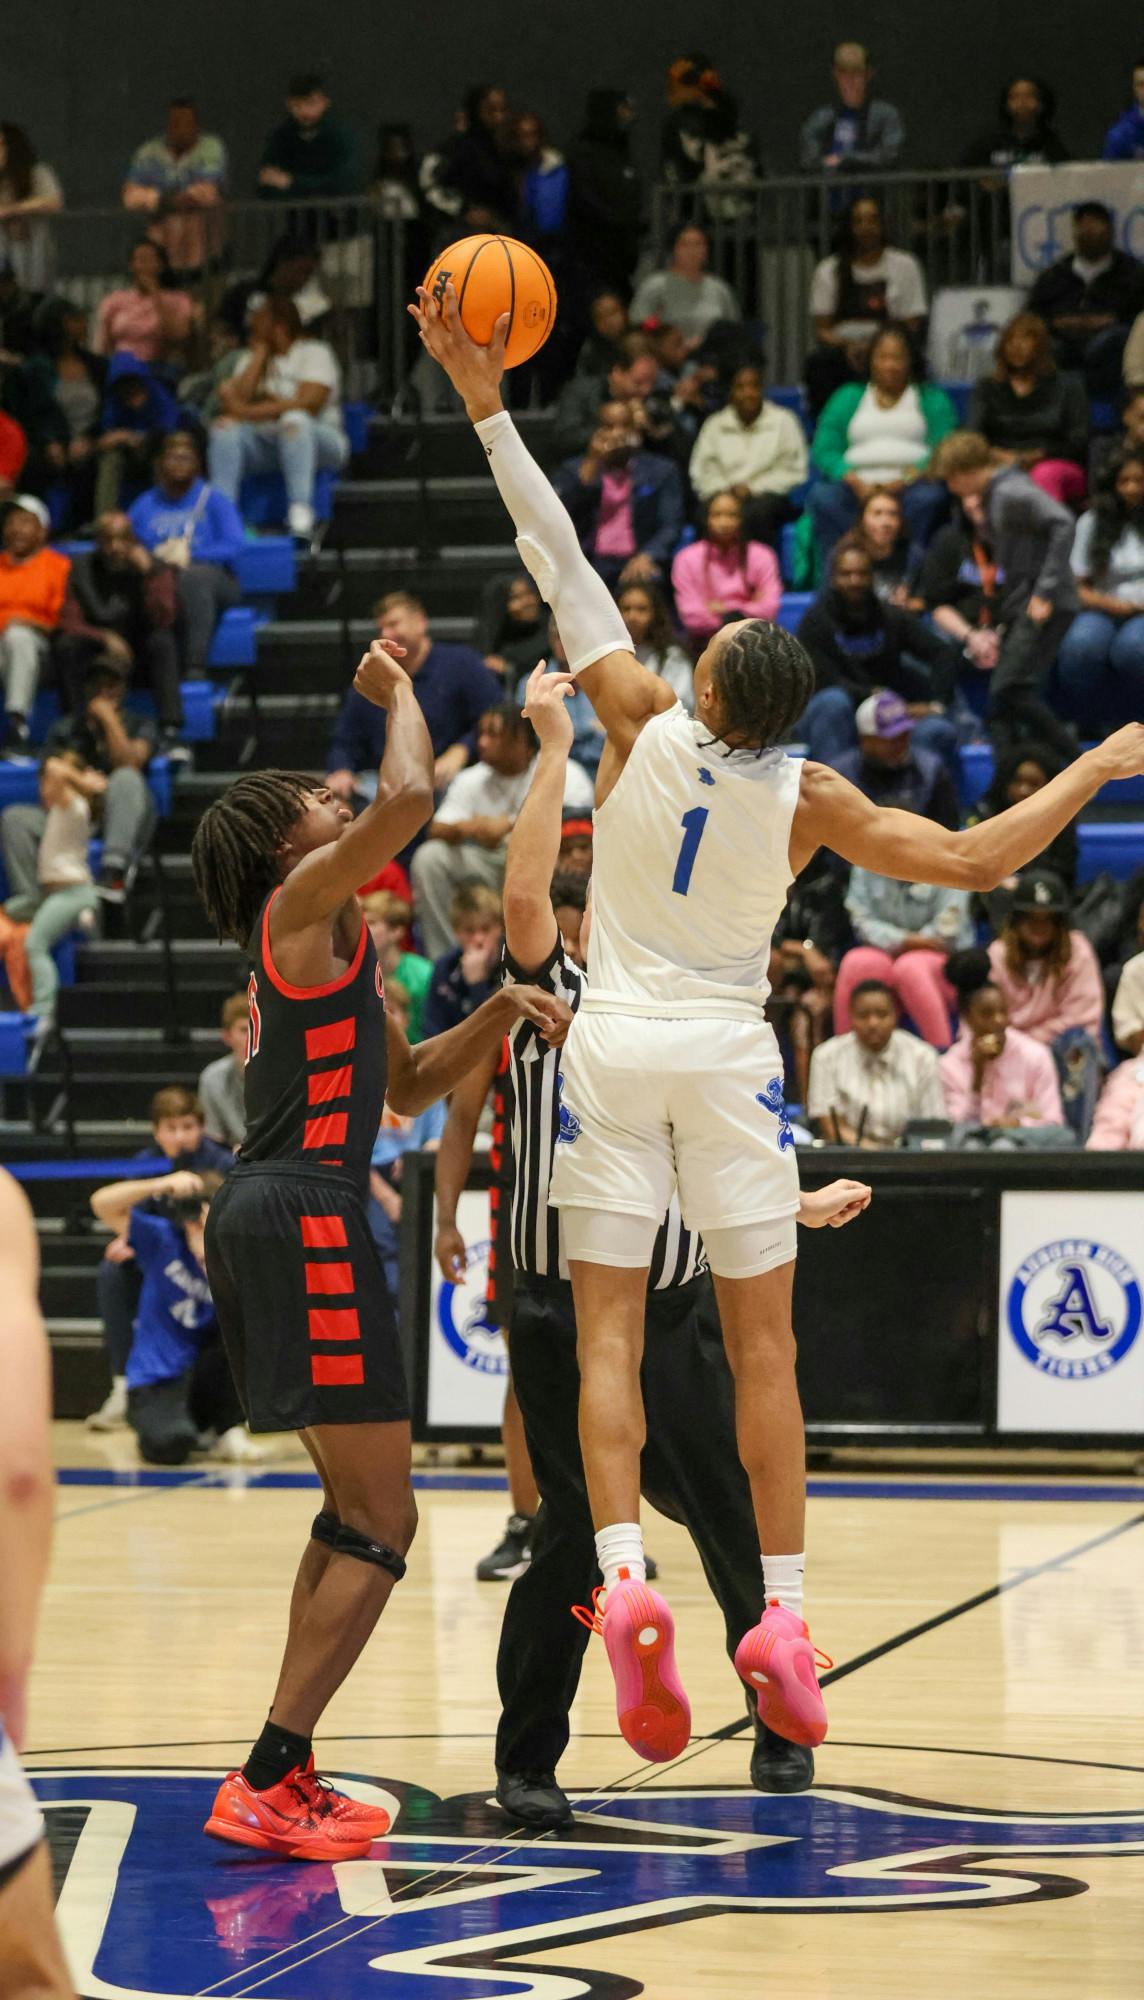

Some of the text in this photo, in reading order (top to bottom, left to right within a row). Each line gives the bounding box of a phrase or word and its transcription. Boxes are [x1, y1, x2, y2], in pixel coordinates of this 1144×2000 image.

[672, 806, 709, 896] 1
[1034, 1260, 1114, 1342] A
[1036, 1351, 1114, 1377] TIGERS
